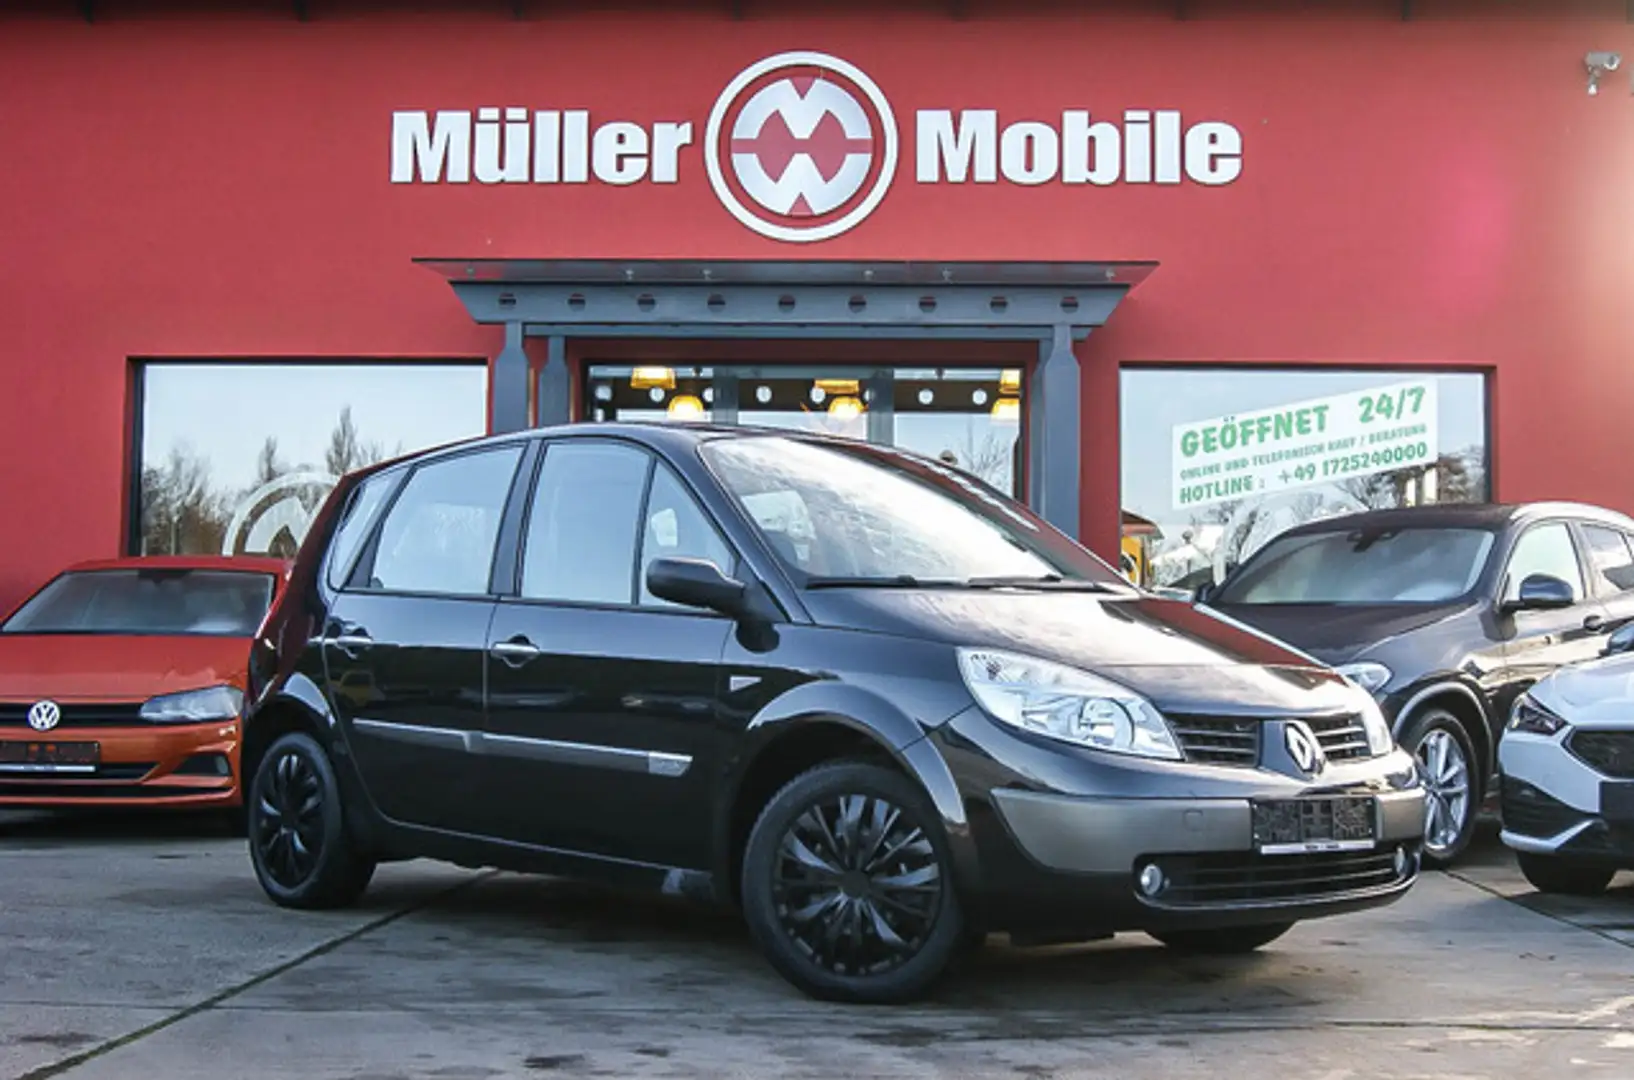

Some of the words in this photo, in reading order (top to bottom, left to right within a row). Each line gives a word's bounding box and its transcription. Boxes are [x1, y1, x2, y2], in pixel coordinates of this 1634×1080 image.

[391, 107, 692, 185] Müller
[916, 109, 1242, 185] Mobile
[1180, 405, 1329, 458] GEÖFFNET
[1358, 386, 1426, 424] 24/7
[1180, 462, 1221, 481] ONLINE
[1180, 474, 1253, 504] HOTLINE
[1322, 441, 1428, 477] 1725240000
